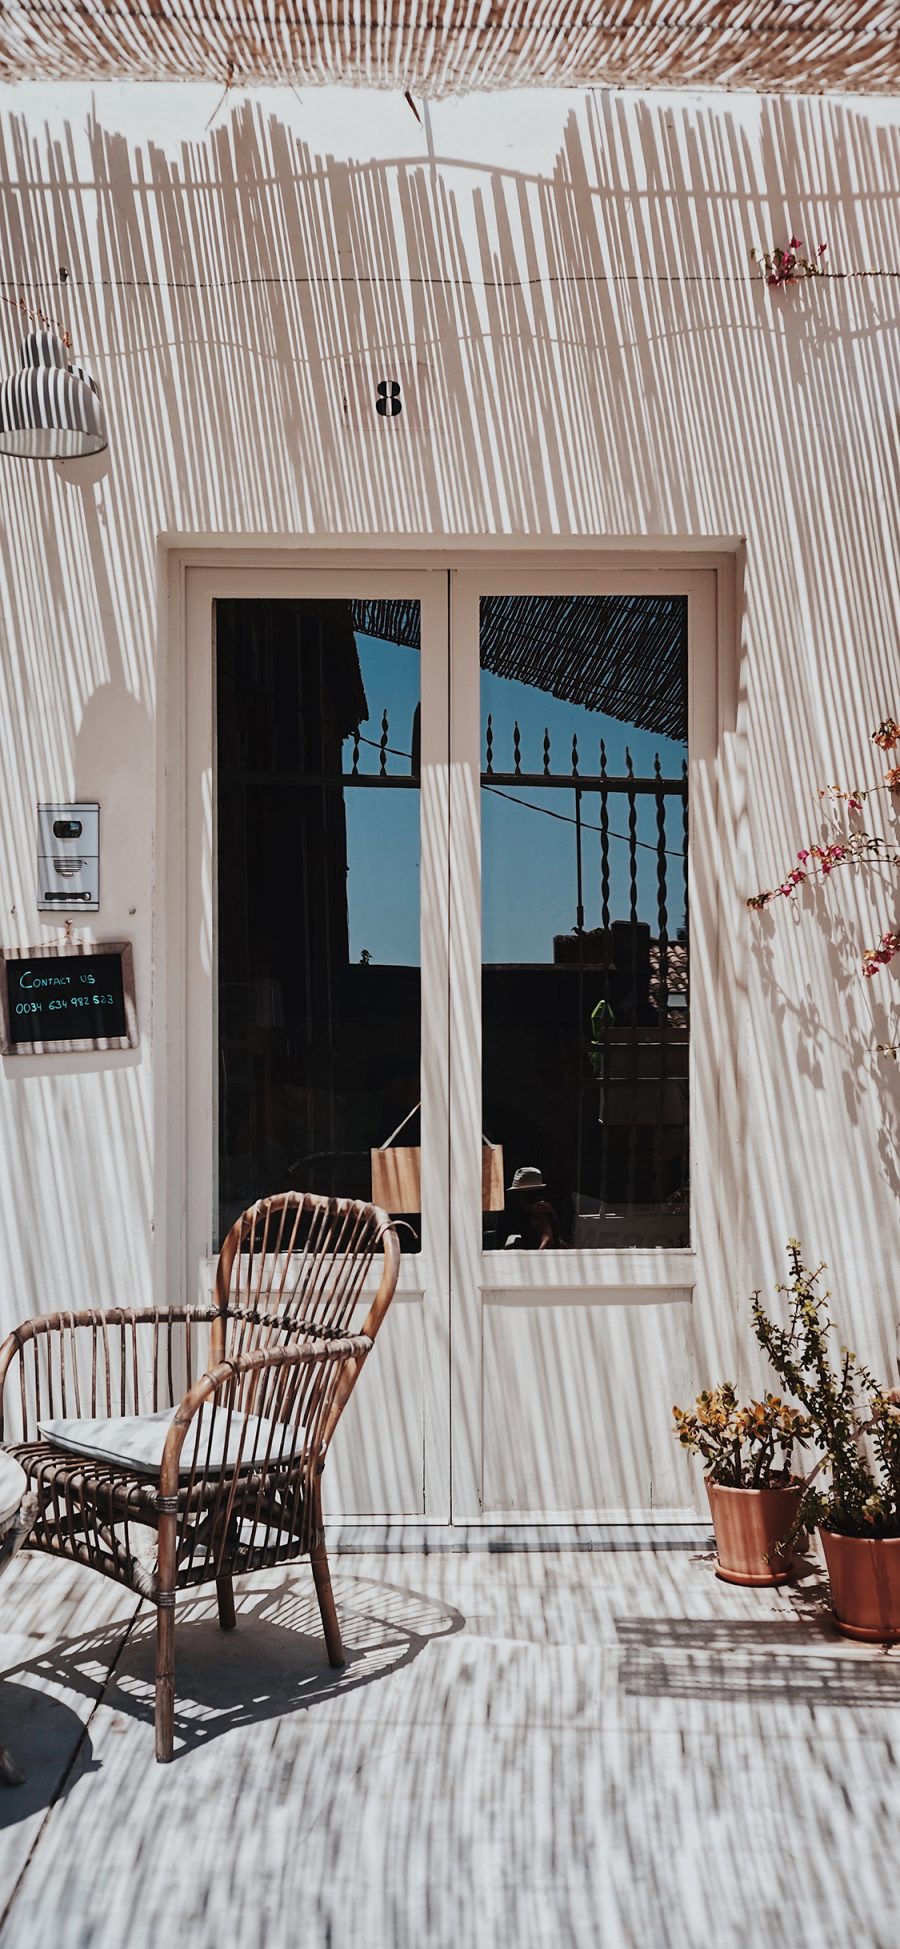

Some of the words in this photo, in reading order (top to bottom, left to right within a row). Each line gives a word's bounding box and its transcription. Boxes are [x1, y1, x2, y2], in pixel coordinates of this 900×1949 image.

[375, 380, 402, 417] 8
[19, 971, 71, 989] CONTACT
[15, 1002, 42, 1014] 0034
[48, 1000, 68, 1010] 634
[70, 997, 90, 1007] 982
[92, 994, 114, 1005] 523
